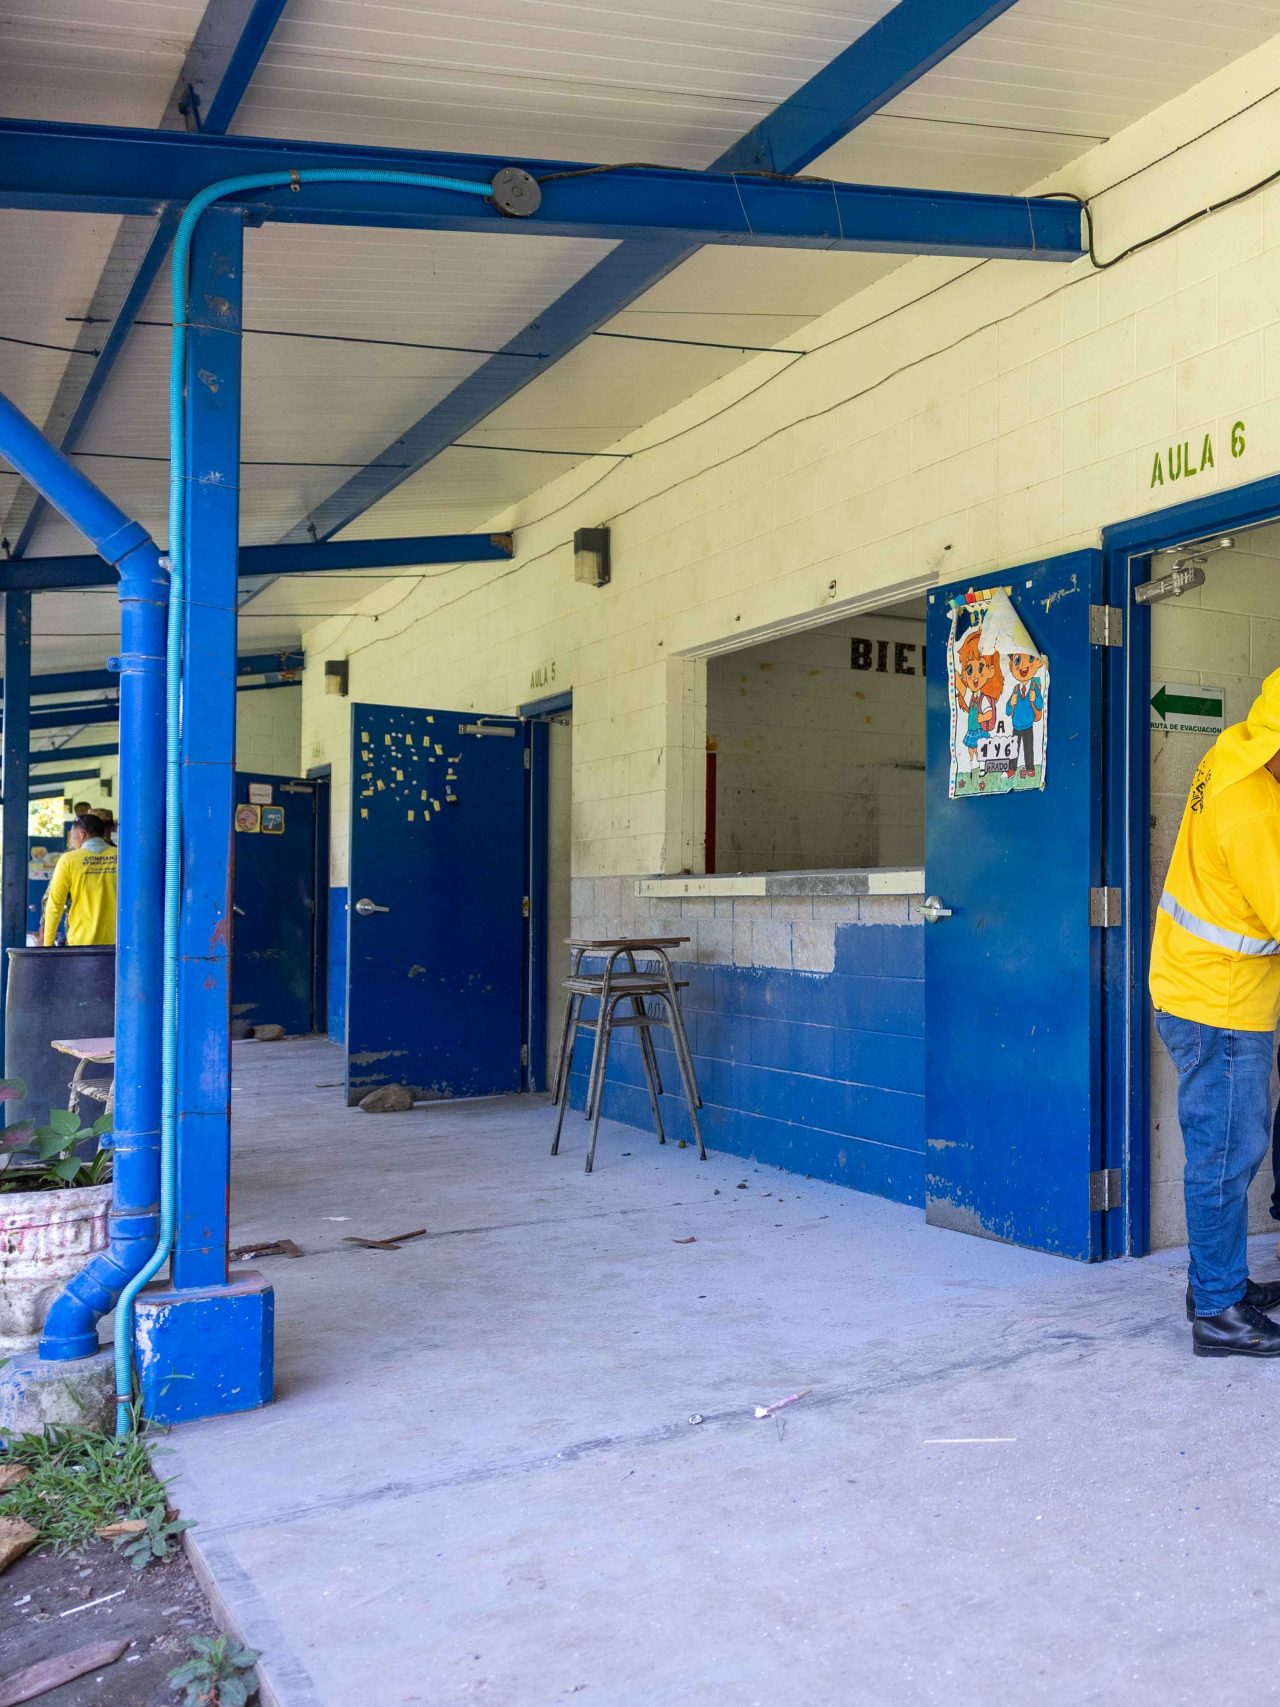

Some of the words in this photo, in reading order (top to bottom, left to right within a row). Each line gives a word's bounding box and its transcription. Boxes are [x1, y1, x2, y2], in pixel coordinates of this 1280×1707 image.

[1150, 433, 1214, 489] AULA
[1231, 420, 1246, 458] 6
[851, 637, 926, 676] BIE
[530, 666, 548, 689] AULA
[551, 661, 556, 681] 5
[996, 720, 1006, 733] A
[1150, 722, 1168, 730] RUTA
[1169, 723, 1179, 731] DE
[986, 762, 1008, 771] GRADO
